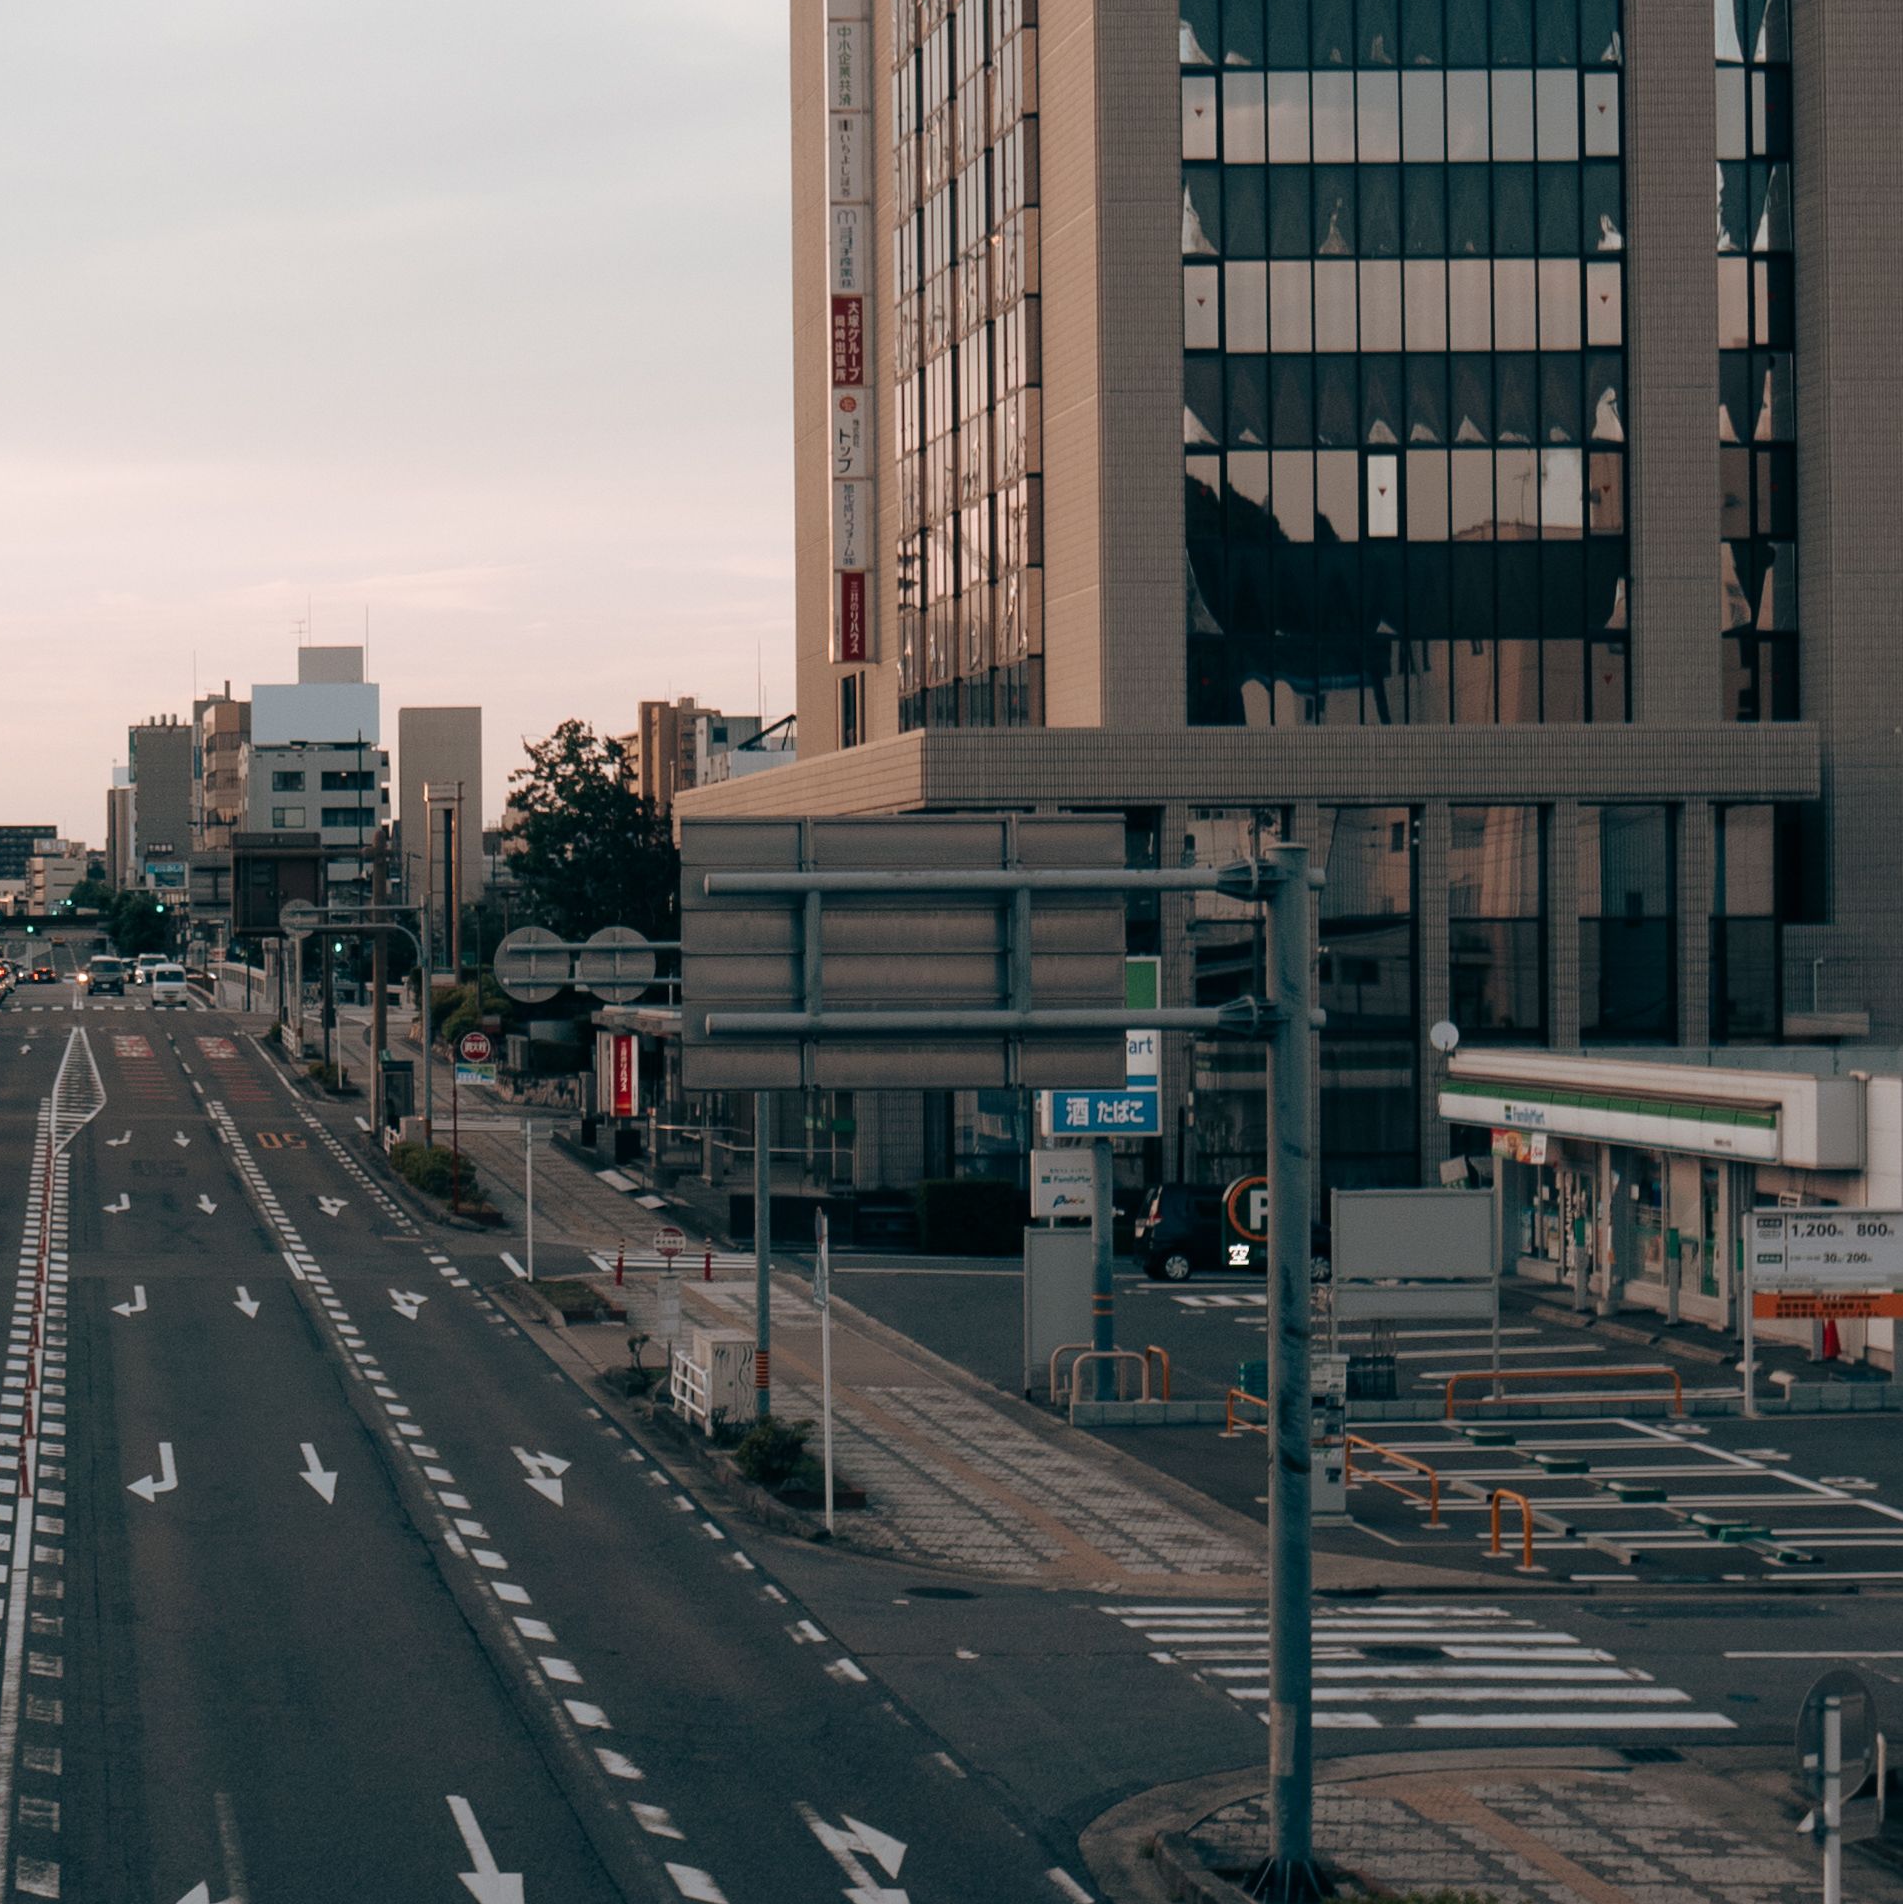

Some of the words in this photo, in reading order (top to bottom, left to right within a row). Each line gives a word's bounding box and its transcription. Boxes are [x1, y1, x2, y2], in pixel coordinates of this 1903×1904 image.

[848, 301, 861, 381] 大塚グループ
[1127, 1036, 1154, 1055] art
[1065, 1096, 1090, 1127] 酒
[1096, 1099, 1145, 1124] たばこ
[1228, 1243, 1251, 1266] 空
